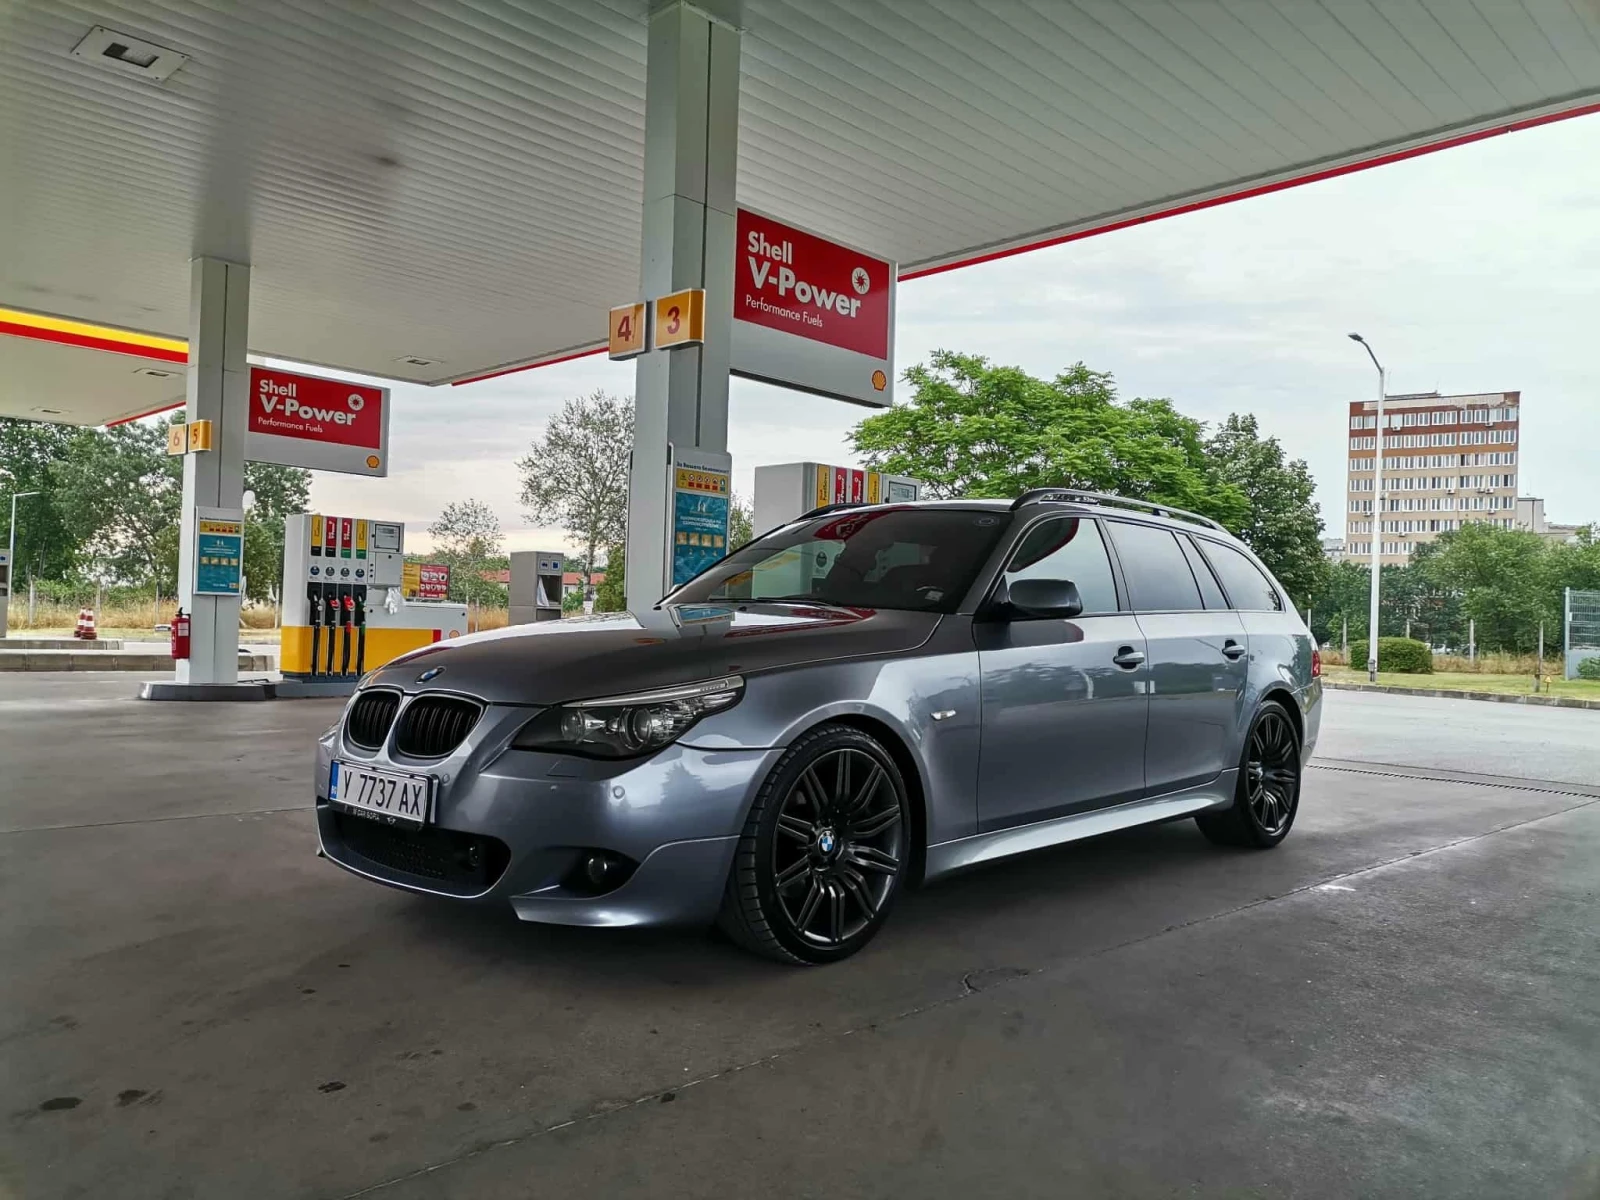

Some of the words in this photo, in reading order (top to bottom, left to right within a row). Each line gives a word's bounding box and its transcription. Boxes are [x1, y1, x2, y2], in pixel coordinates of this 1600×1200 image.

[748, 231, 792, 264] Shell
[748, 256, 861, 318] V-Power
[667, 306, 681, 334] 3
[746, 294, 801, 321] Performance
[803, 311, 823, 328] Fuels
[617, 315, 632, 342] 4
[260, 379, 297, 397] Shell
[260, 394, 356, 426] V-Power
[192, 429, 198, 444] 5
[258, 417, 304, 431] Performance
[305, 423, 323, 433] Fuels
[173, 433, 180, 446] 6
[358, 774, 397, 809] 7737
[399, 782, 422, 815] AX
